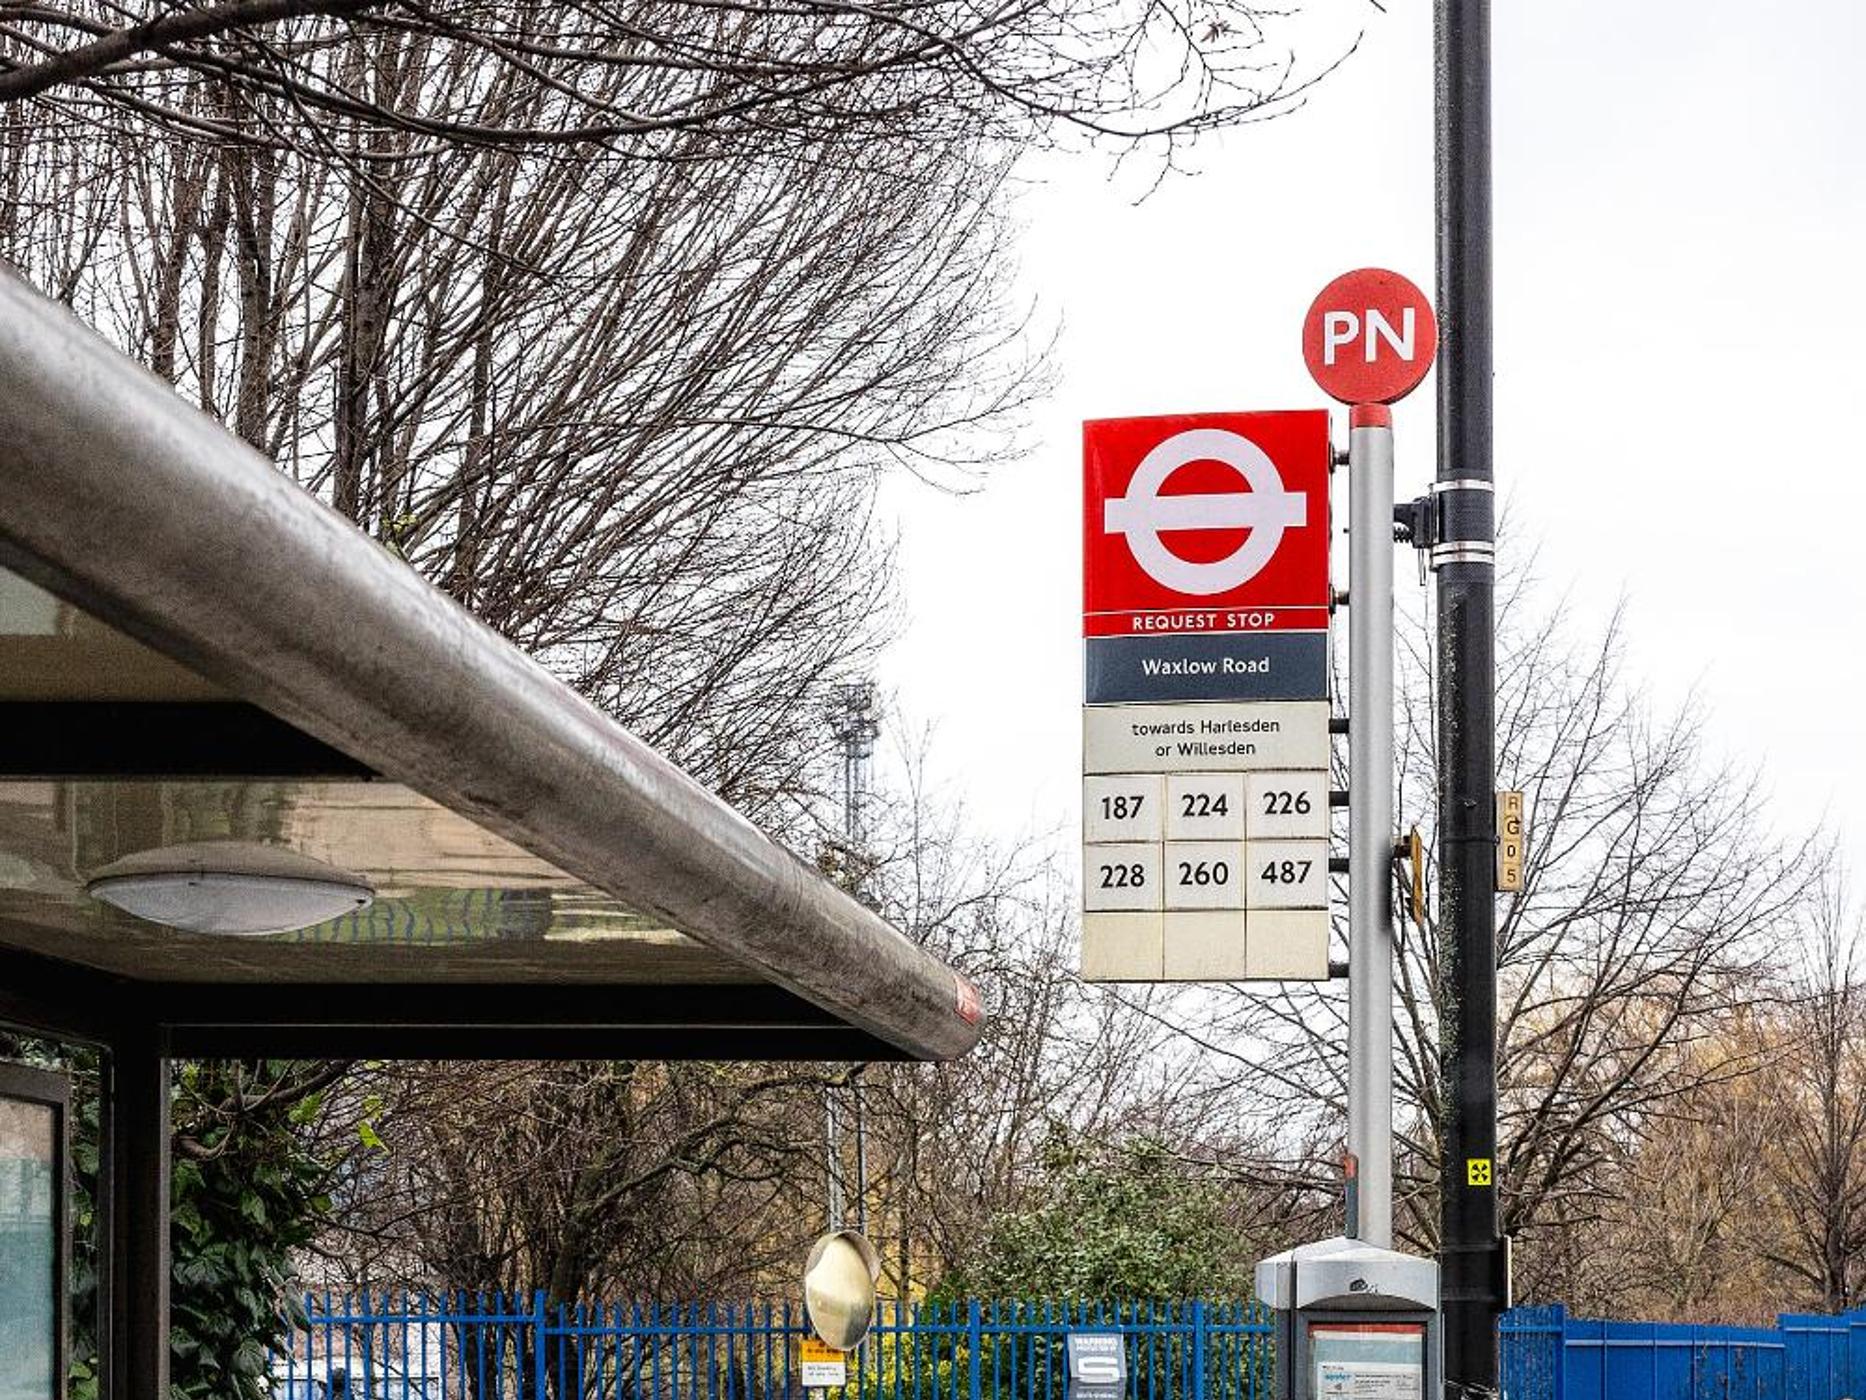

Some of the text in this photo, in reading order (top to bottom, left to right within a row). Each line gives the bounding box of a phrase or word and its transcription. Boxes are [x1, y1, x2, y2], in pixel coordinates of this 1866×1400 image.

[1323, 306, 1415, 366] PN
[1133, 613, 1275, 630] REQUEST STOP
[1142, 657, 1270, 675] Waxlow Road
[1132, 719, 1280, 736] towards Harlesden
[1155, 742, 1256, 757] or Willesden
[1102, 796, 1145, 820] 187
[1181, 793, 1228, 817] 224
[1263, 791, 1312, 815] 226
[1100, 864, 1145, 888] 228
[1178, 862, 1228, 885] 260
[1261, 861, 1312, 884] 487
